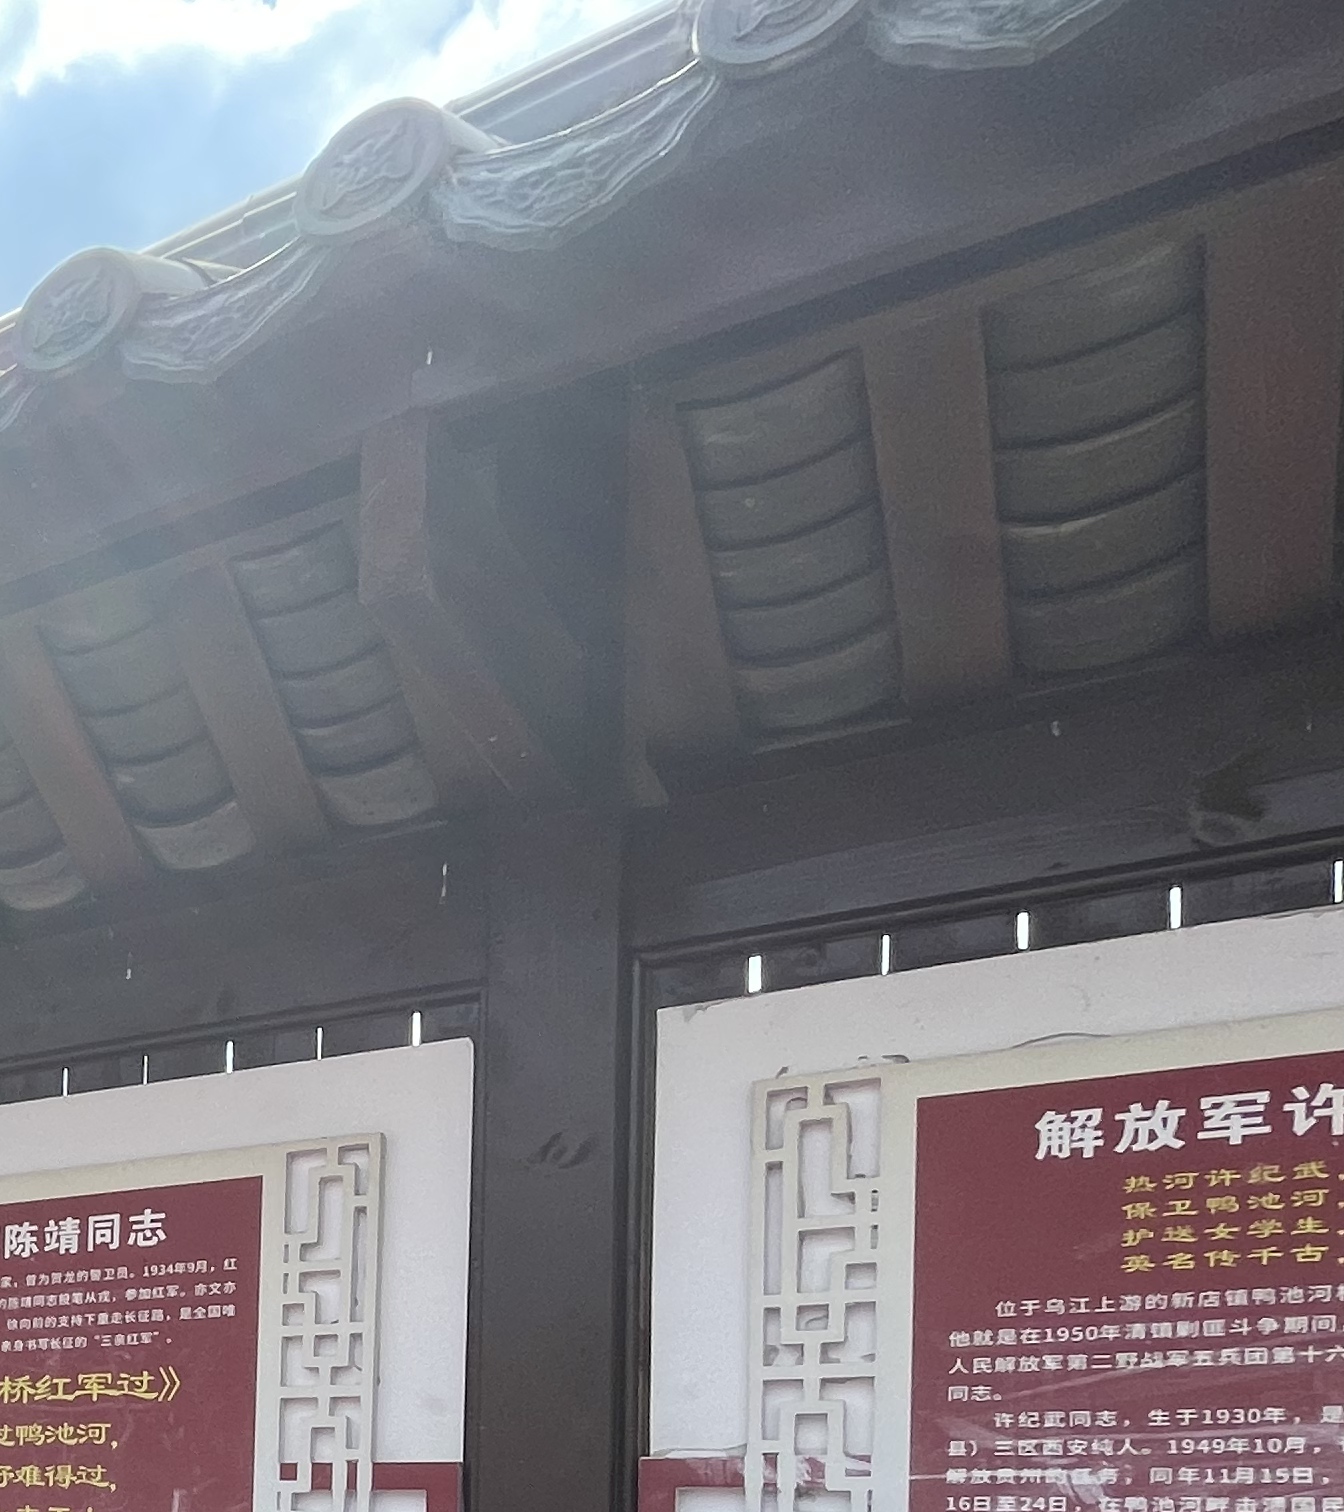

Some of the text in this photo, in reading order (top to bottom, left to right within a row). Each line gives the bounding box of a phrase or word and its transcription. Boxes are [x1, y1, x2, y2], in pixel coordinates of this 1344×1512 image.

[1034, 1082, 1344, 1161] 解放军许
[948, 1386, 1002, 1401] 同志。
